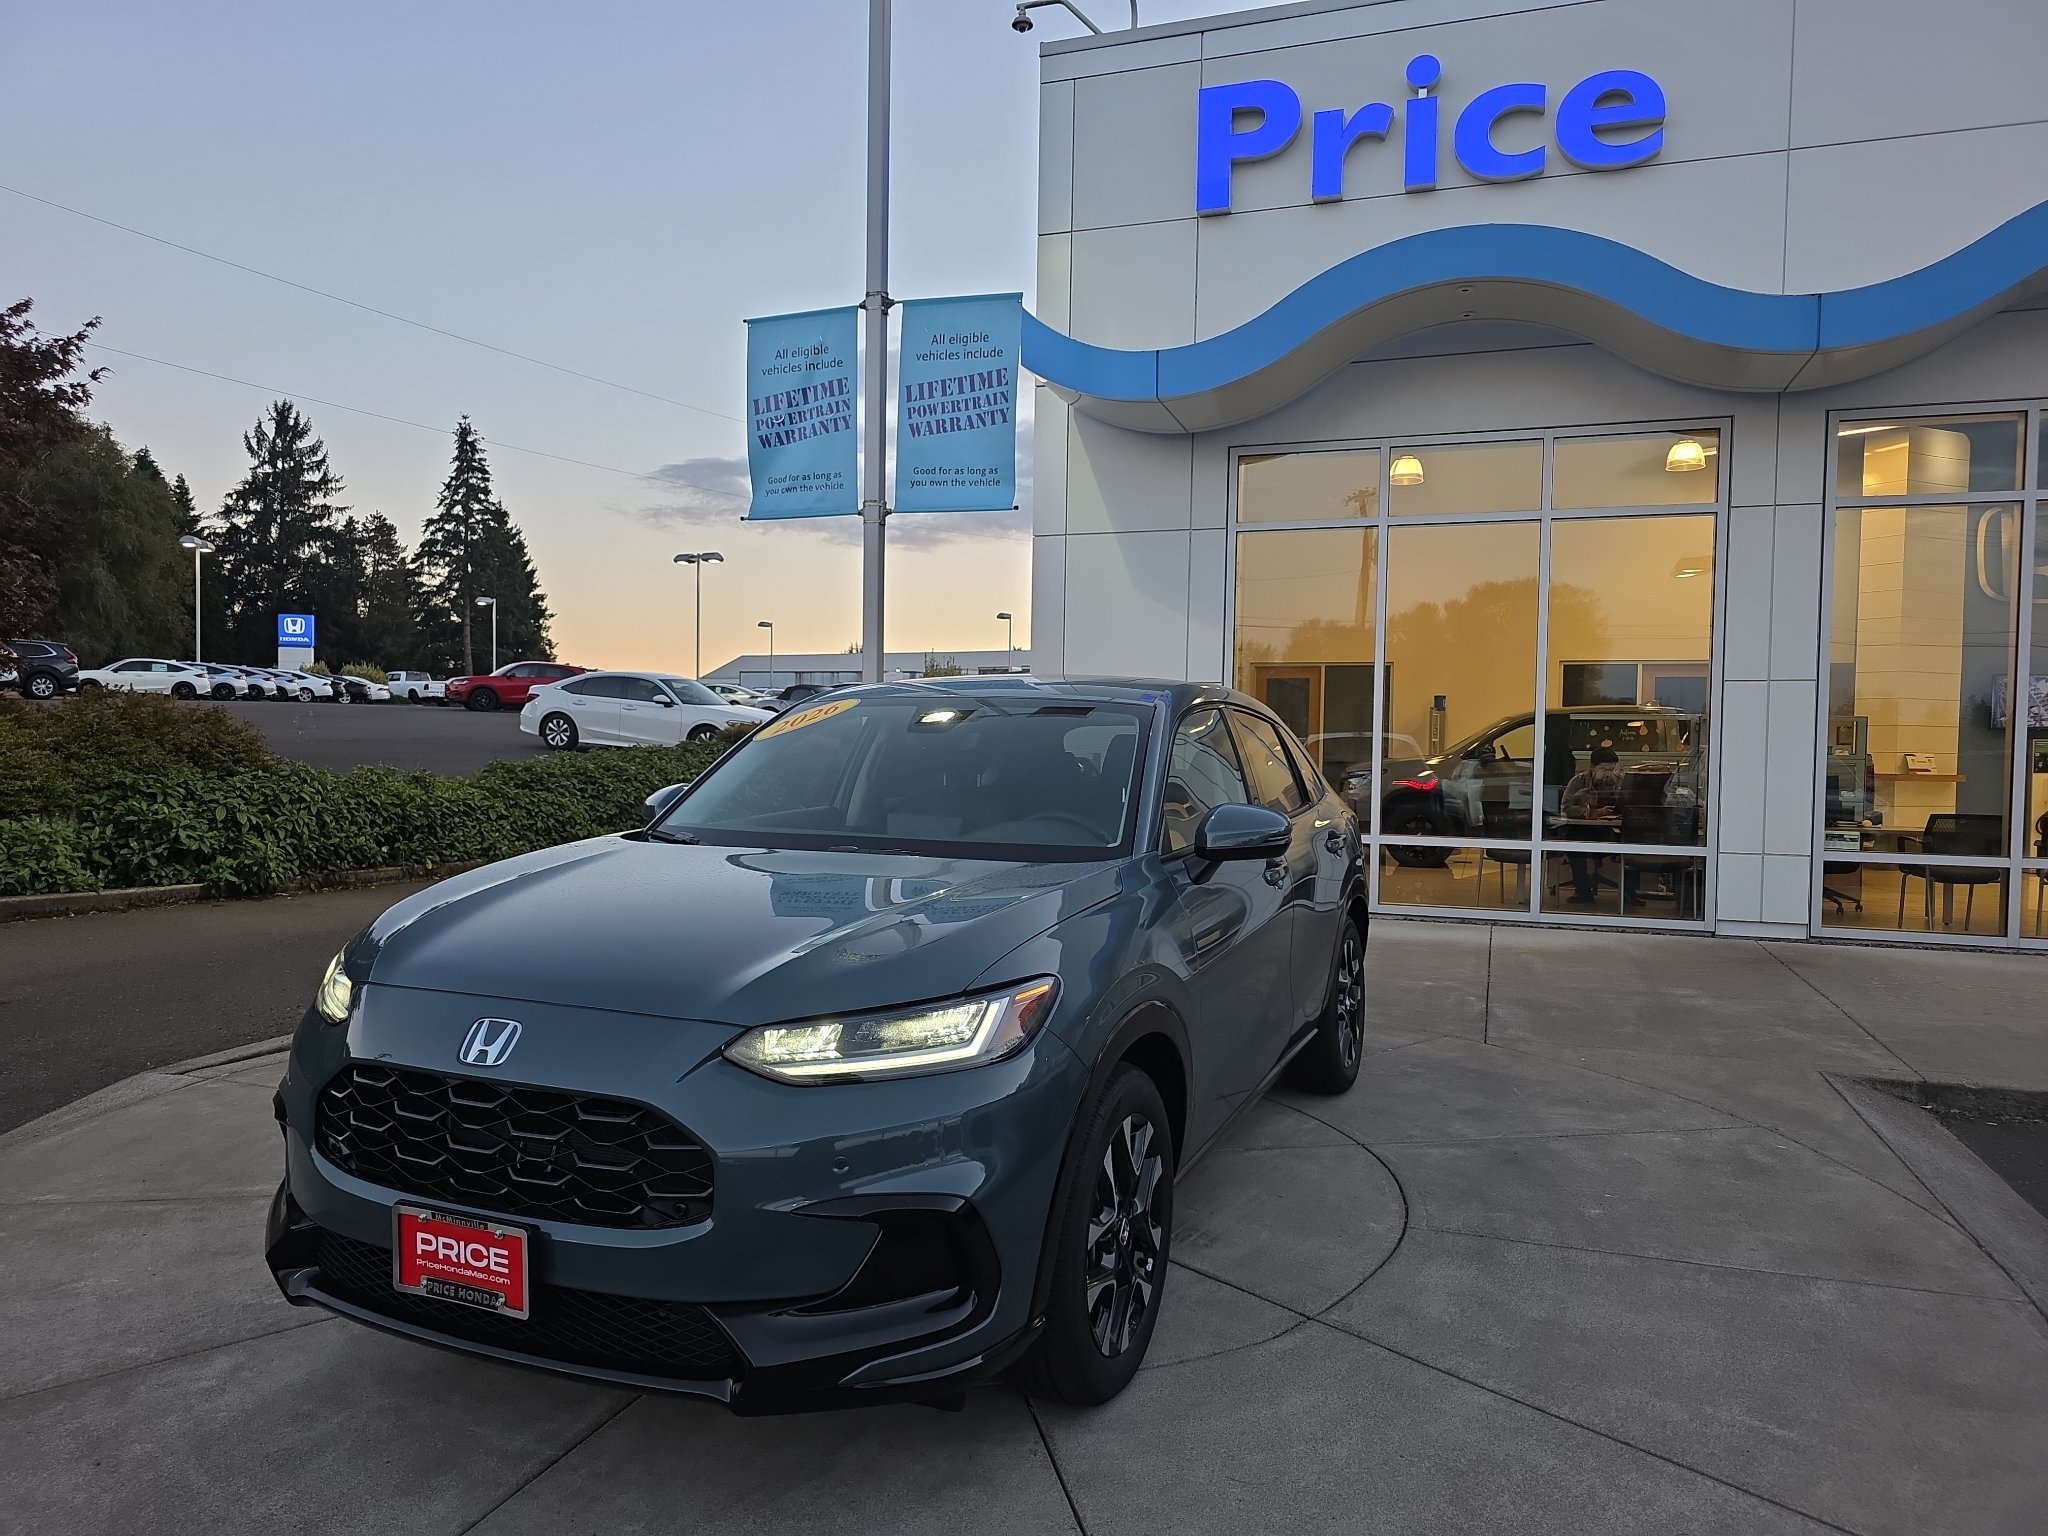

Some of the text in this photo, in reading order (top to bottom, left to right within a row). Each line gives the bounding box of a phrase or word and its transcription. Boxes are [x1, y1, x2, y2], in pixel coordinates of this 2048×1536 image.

[1196, 54, 1667, 217] Price
[774, 343, 830, 360] All eligible
[931, 331, 990, 347] All eligible
[761, 357, 843, 376] vehicles include
[916, 346, 1004, 362] vehicles include
[752, 377, 850, 416] LIFETIME
[904, 367, 1009, 404] LIFETIME
[755, 398, 851, 432] POWERTRAIN
[907, 390, 1010, 420] POWERTRAIN
[757, 414, 851, 449] WARRANTY
[908, 406, 1010, 438] WARRANTY
[767, 475, 787, 484] Good
[813, 472, 832, 481] long
[910, 478, 1001, 489] you own the vehicle
[913, 466, 937, 475] Good
[938, 466, 953, 475] for
[967, 466, 987, 477] long
[988, 467, 999, 475] as
[765, 488, 779, 497] you
[799, 484, 814, 493] the
[435, 1213, 485, 1231] McMinnville
[416, 1231, 509, 1274] PRICE
[416, 1258, 511, 1286] PriceHondaMac.com
[427, 1281, 499, 1307] PRICE HONDA
